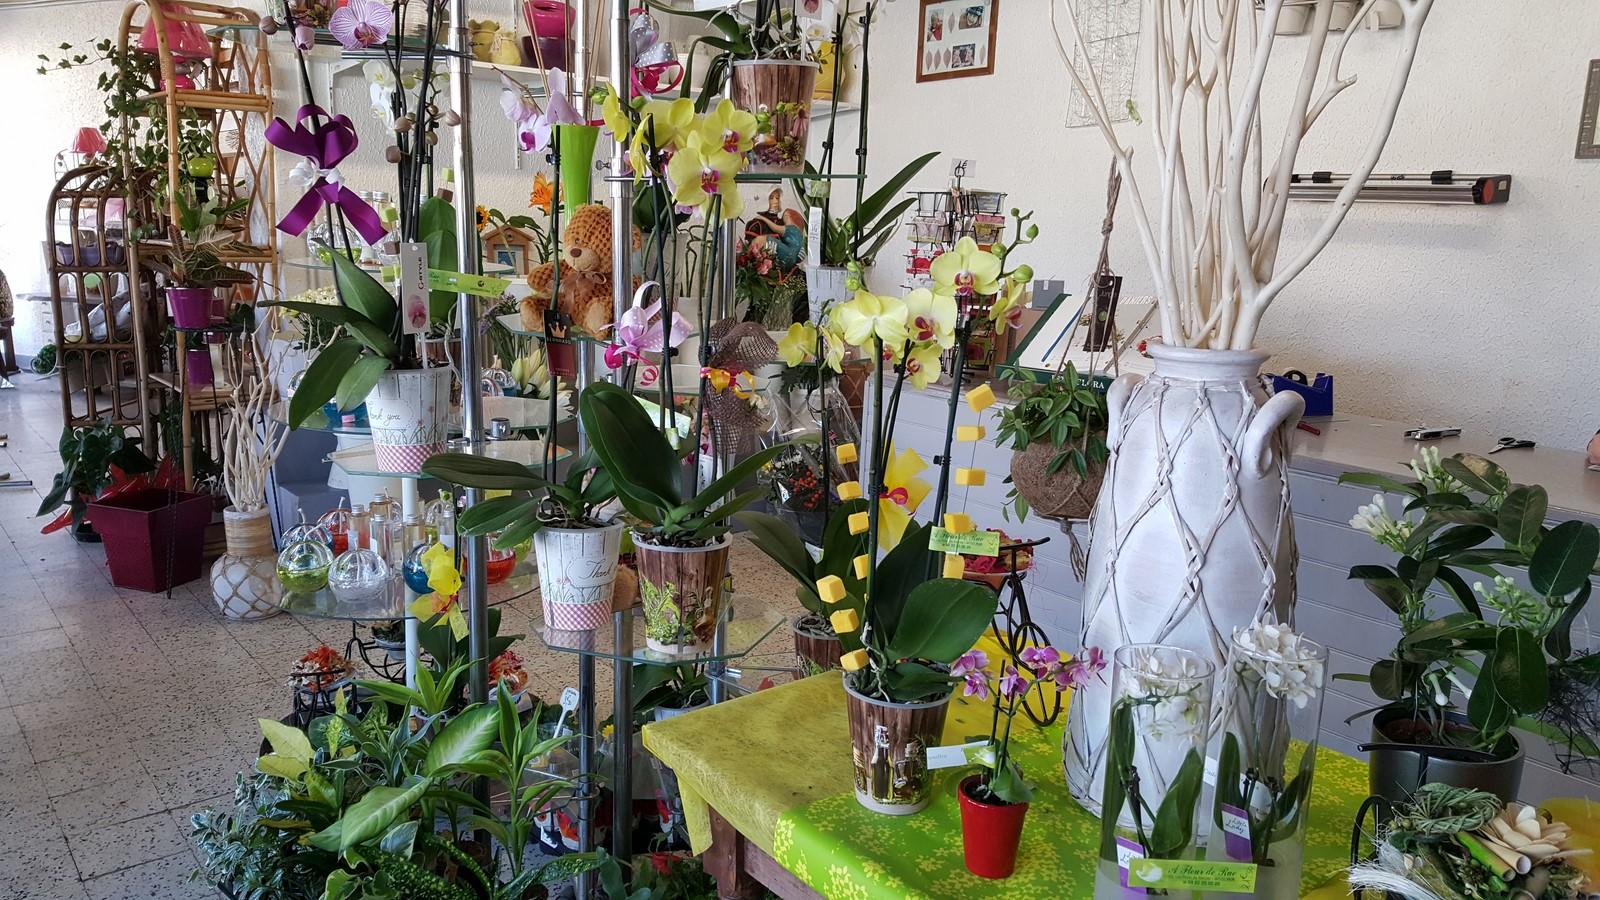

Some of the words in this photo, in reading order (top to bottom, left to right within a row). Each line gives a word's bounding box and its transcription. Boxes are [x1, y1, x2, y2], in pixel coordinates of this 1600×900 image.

[1181, 864, 1203, 875] Fleur
[1206, 865, 1216, 875] de
[1218, 866, 1237, 876] Rue
